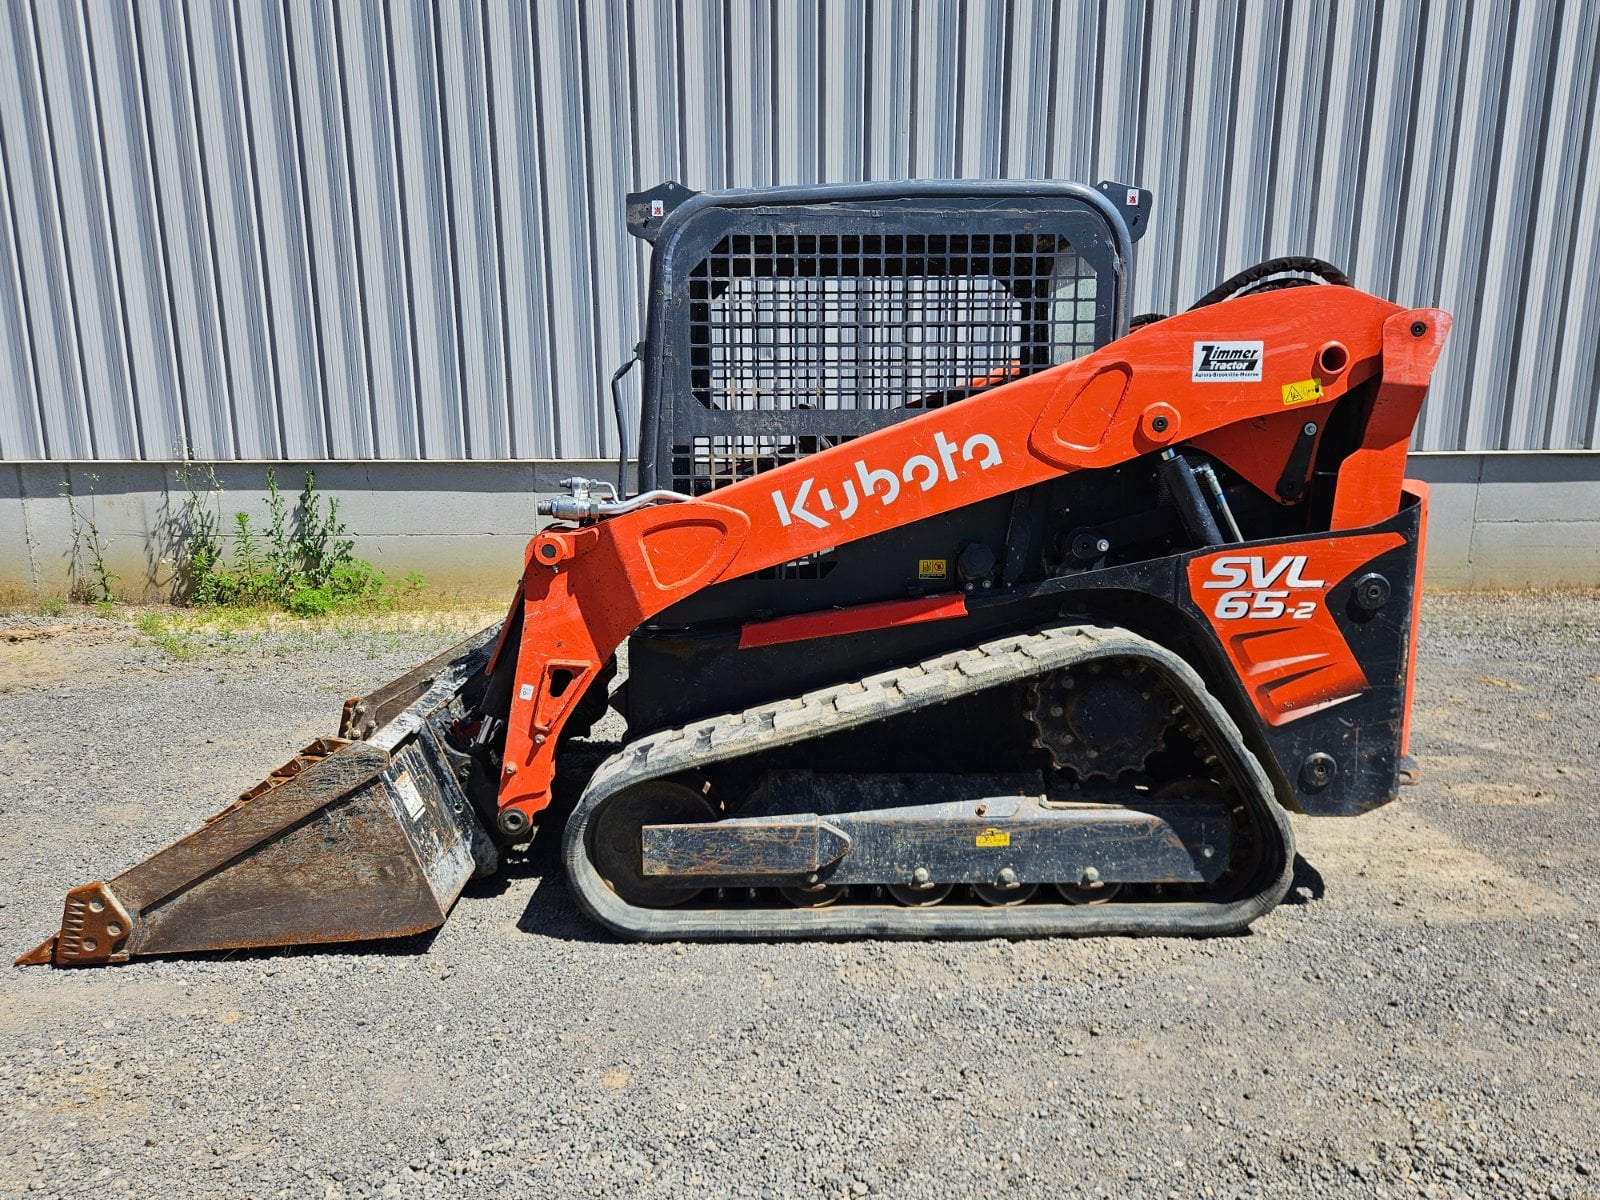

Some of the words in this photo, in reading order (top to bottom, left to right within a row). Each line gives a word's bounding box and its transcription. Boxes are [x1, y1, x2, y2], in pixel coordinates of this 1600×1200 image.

[1199, 345, 1259, 371] Zimmer
[1210, 360, 1249, 370] Tractor
[771, 431, 1003, 529] Kubota
[1202, 555, 1326, 589] SVL
[1214, 590, 1317, 620] 65-2
